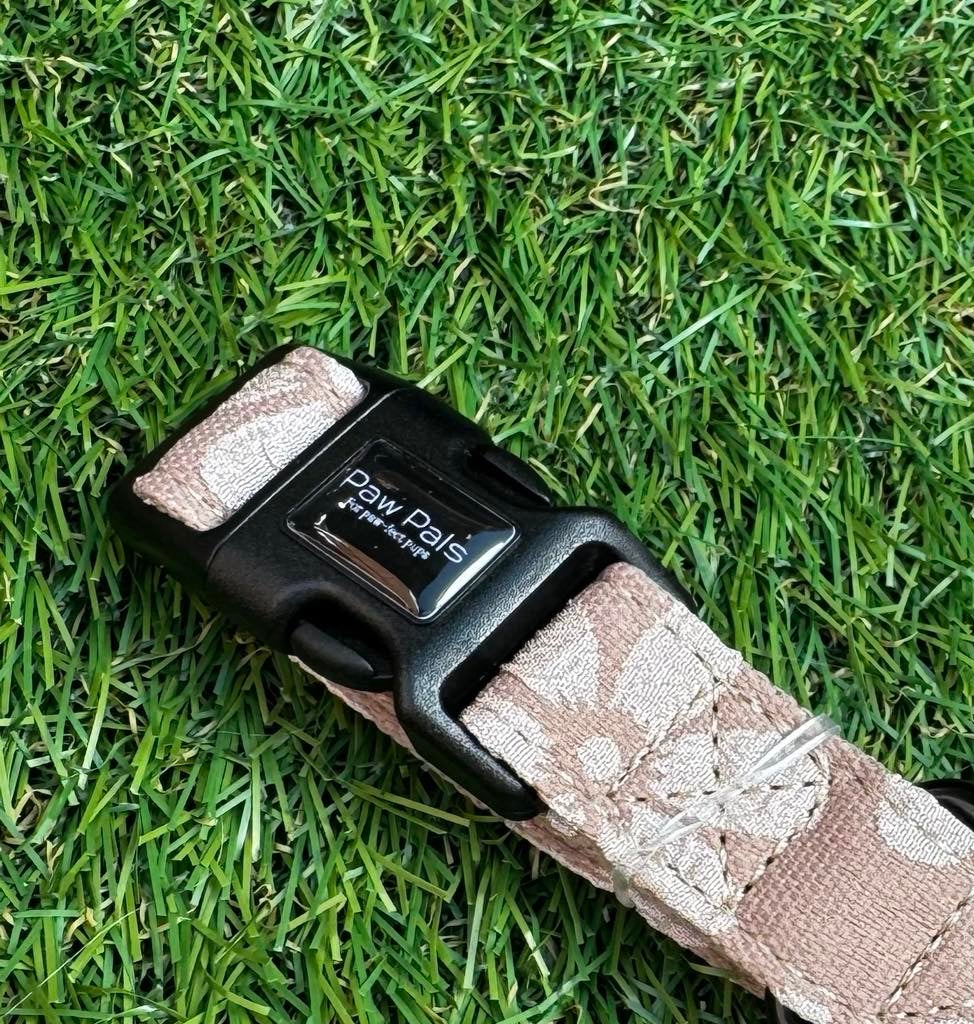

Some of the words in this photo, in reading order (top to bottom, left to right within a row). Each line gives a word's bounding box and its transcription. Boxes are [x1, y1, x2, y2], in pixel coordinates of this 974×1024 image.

[339, 468, 404, 516] Paw
[401, 508, 468, 563] Pals
[344, 497, 363, 514] For
[401, 539, 430, 560] pups
